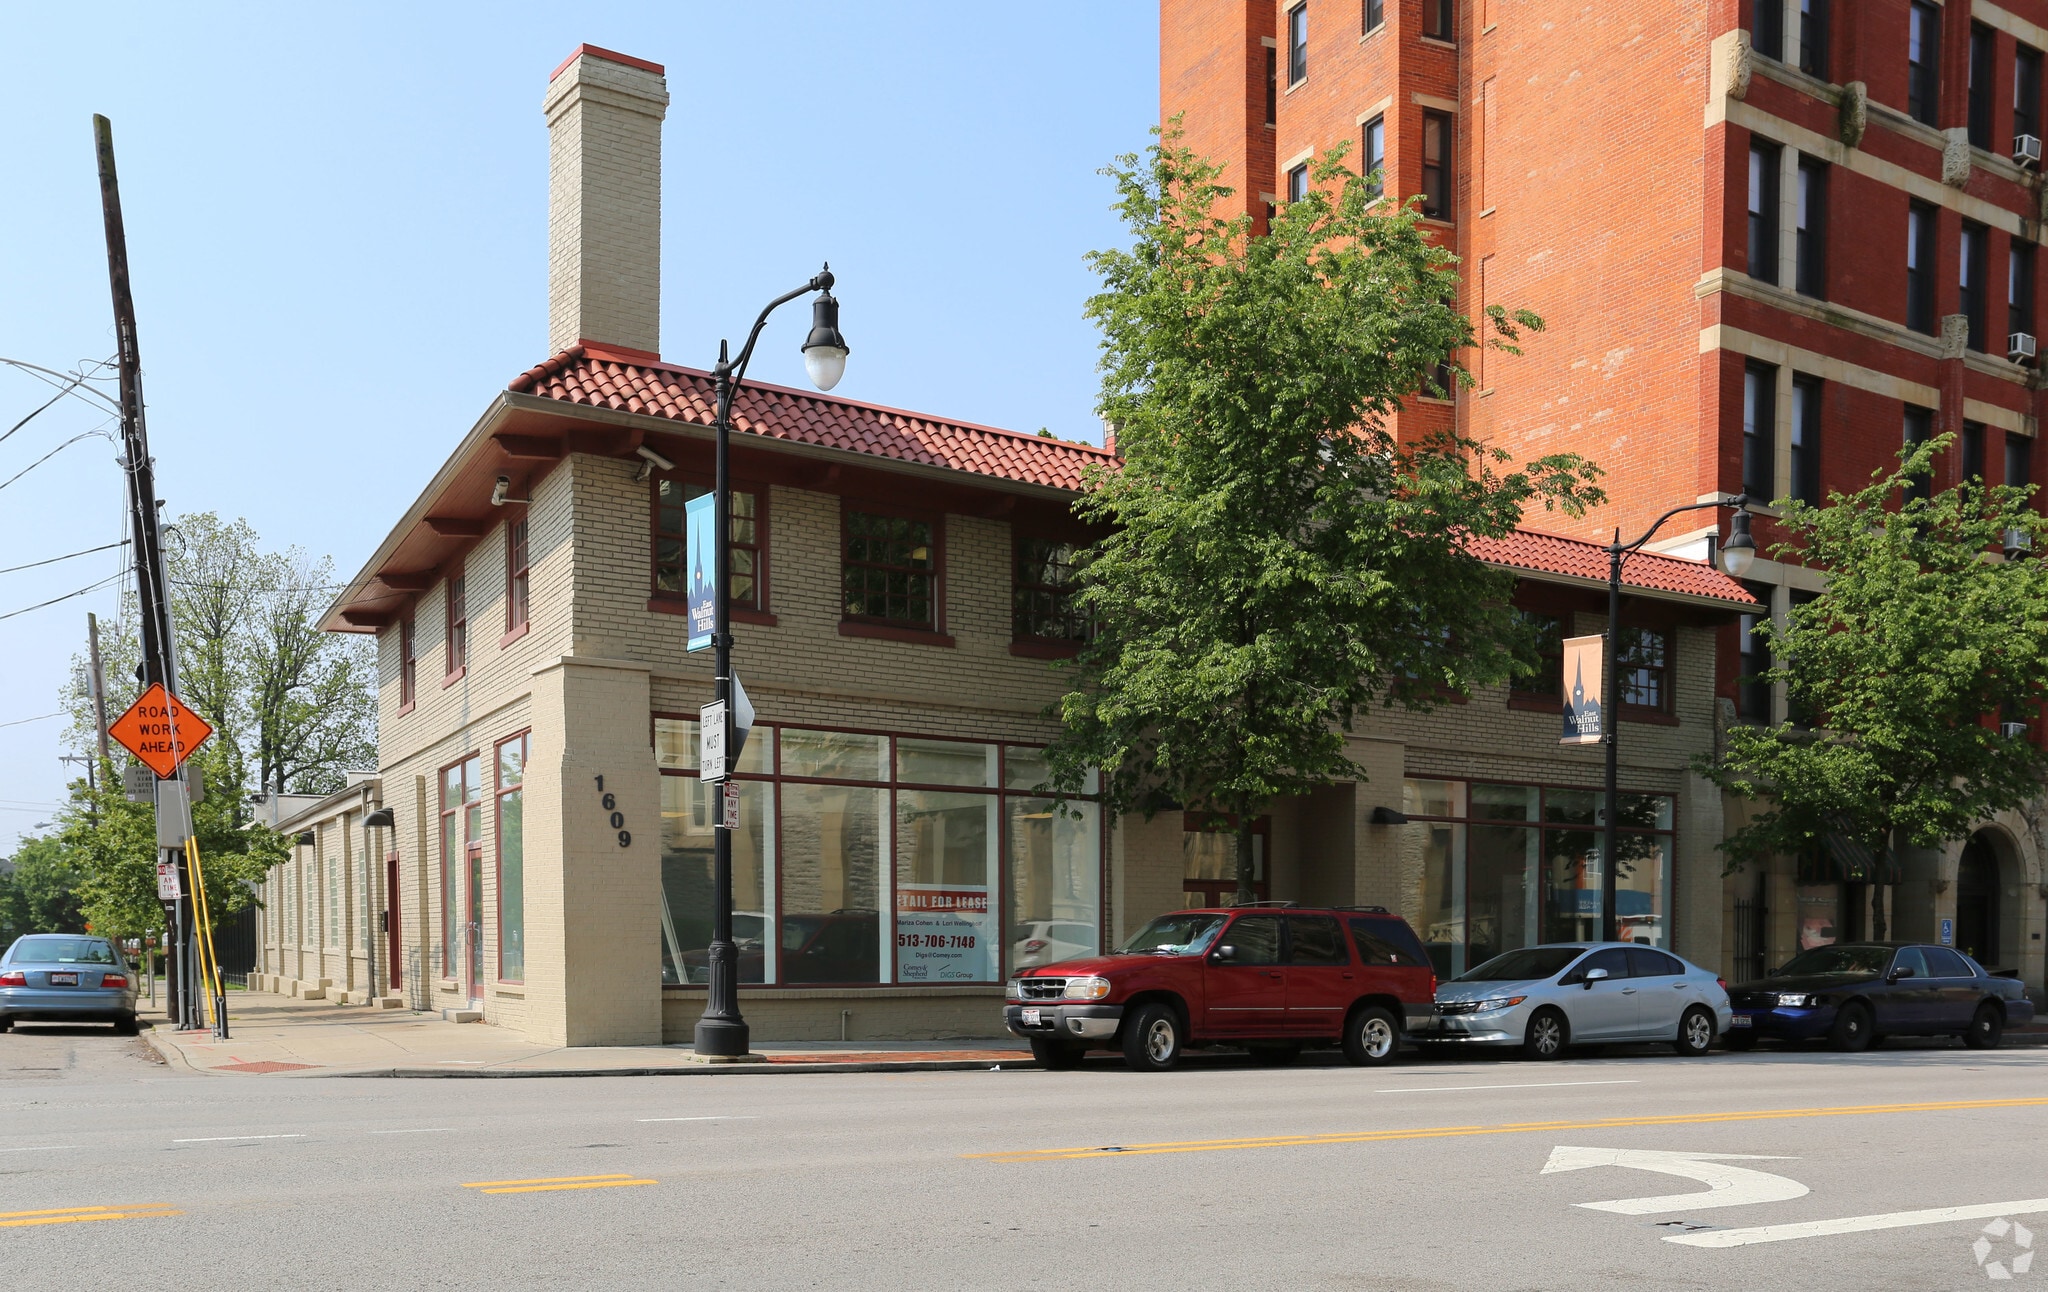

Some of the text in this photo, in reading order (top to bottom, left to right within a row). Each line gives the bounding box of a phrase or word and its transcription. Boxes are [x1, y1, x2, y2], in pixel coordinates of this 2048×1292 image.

[702, 600, 712, 609] East
[691, 605, 714, 621] Walnut
[697, 617, 714, 632] Hills
[138, 706, 179, 718] ROAD
[702, 711, 723, 728] LEFT LANE
[1569, 714, 1599, 725] Walnut
[139, 724, 182, 735] WORK
[1577, 723, 1599, 734] Hills
[139, 741, 185, 753] AHEAD
[706, 733, 720, 751] MUST
[702, 756, 724, 772] TURN LEFT
[727, 800, 736, 808] ANY
[727, 809, 737, 819] TIME
[931, 896, 952, 908] FOR
[956, 897, 987, 909] LEASE
[898, 934, 975, 948] 513-706-7148
[903, 970, 928, 978] Shepherd
[956, 971, 973, 980] Group
